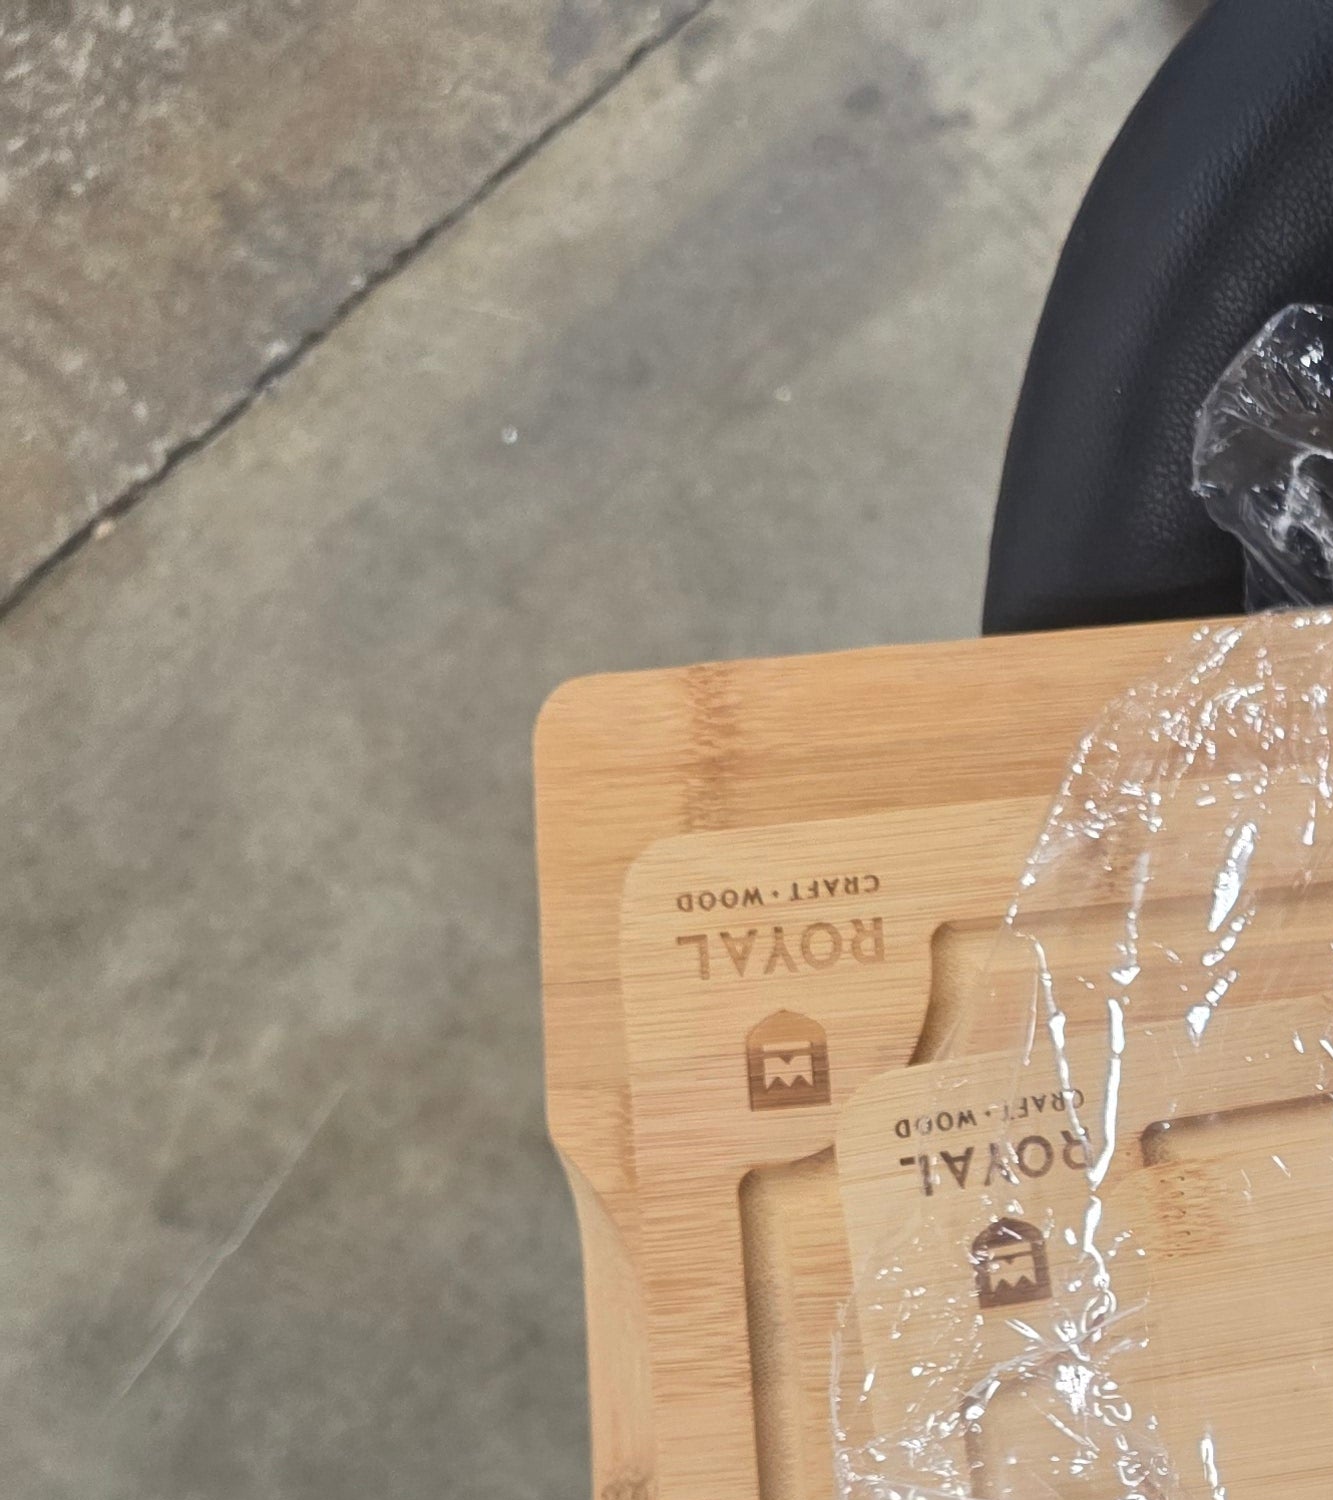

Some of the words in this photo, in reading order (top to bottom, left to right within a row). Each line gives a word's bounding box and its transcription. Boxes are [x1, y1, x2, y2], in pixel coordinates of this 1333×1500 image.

[676, 889, 764, 912] WOOD
[790, 874, 881, 902] CRAFT
[676, 916, 886, 981] ROYAL
[895, 1107, 977, 1139] WOOD
